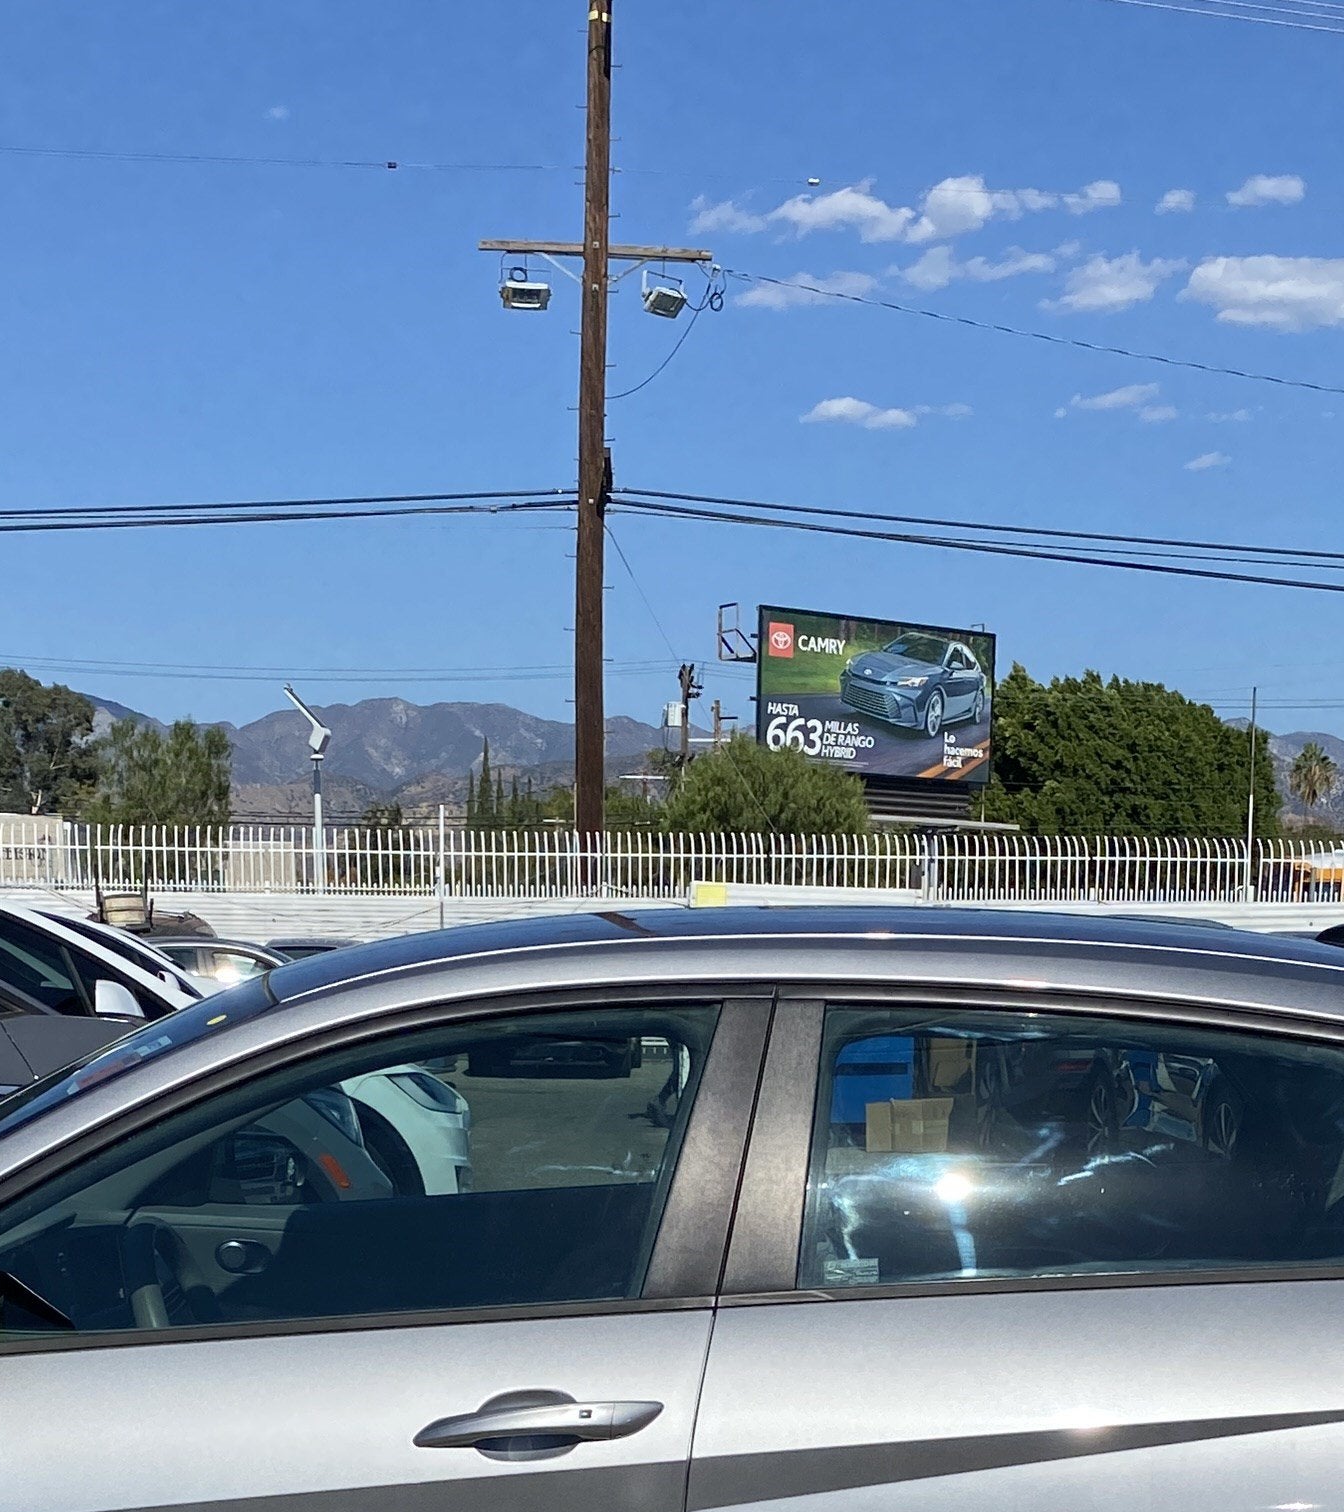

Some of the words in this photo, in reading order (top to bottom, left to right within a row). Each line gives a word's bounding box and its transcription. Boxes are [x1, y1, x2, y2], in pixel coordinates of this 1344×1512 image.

[798, 634, 846, 655] CAMRY
[767, 701, 799, 716] HASTA
[824, 720, 860, 734] MILLAS
[766, 716, 823, 756] 663
[822, 733, 837, 745] DE
[837, 735, 875, 749] RANGO
[944, 731, 956, 743] Lo
[820, 745, 857, 759] HYBRID
[944, 743, 984, 758] hacemos
